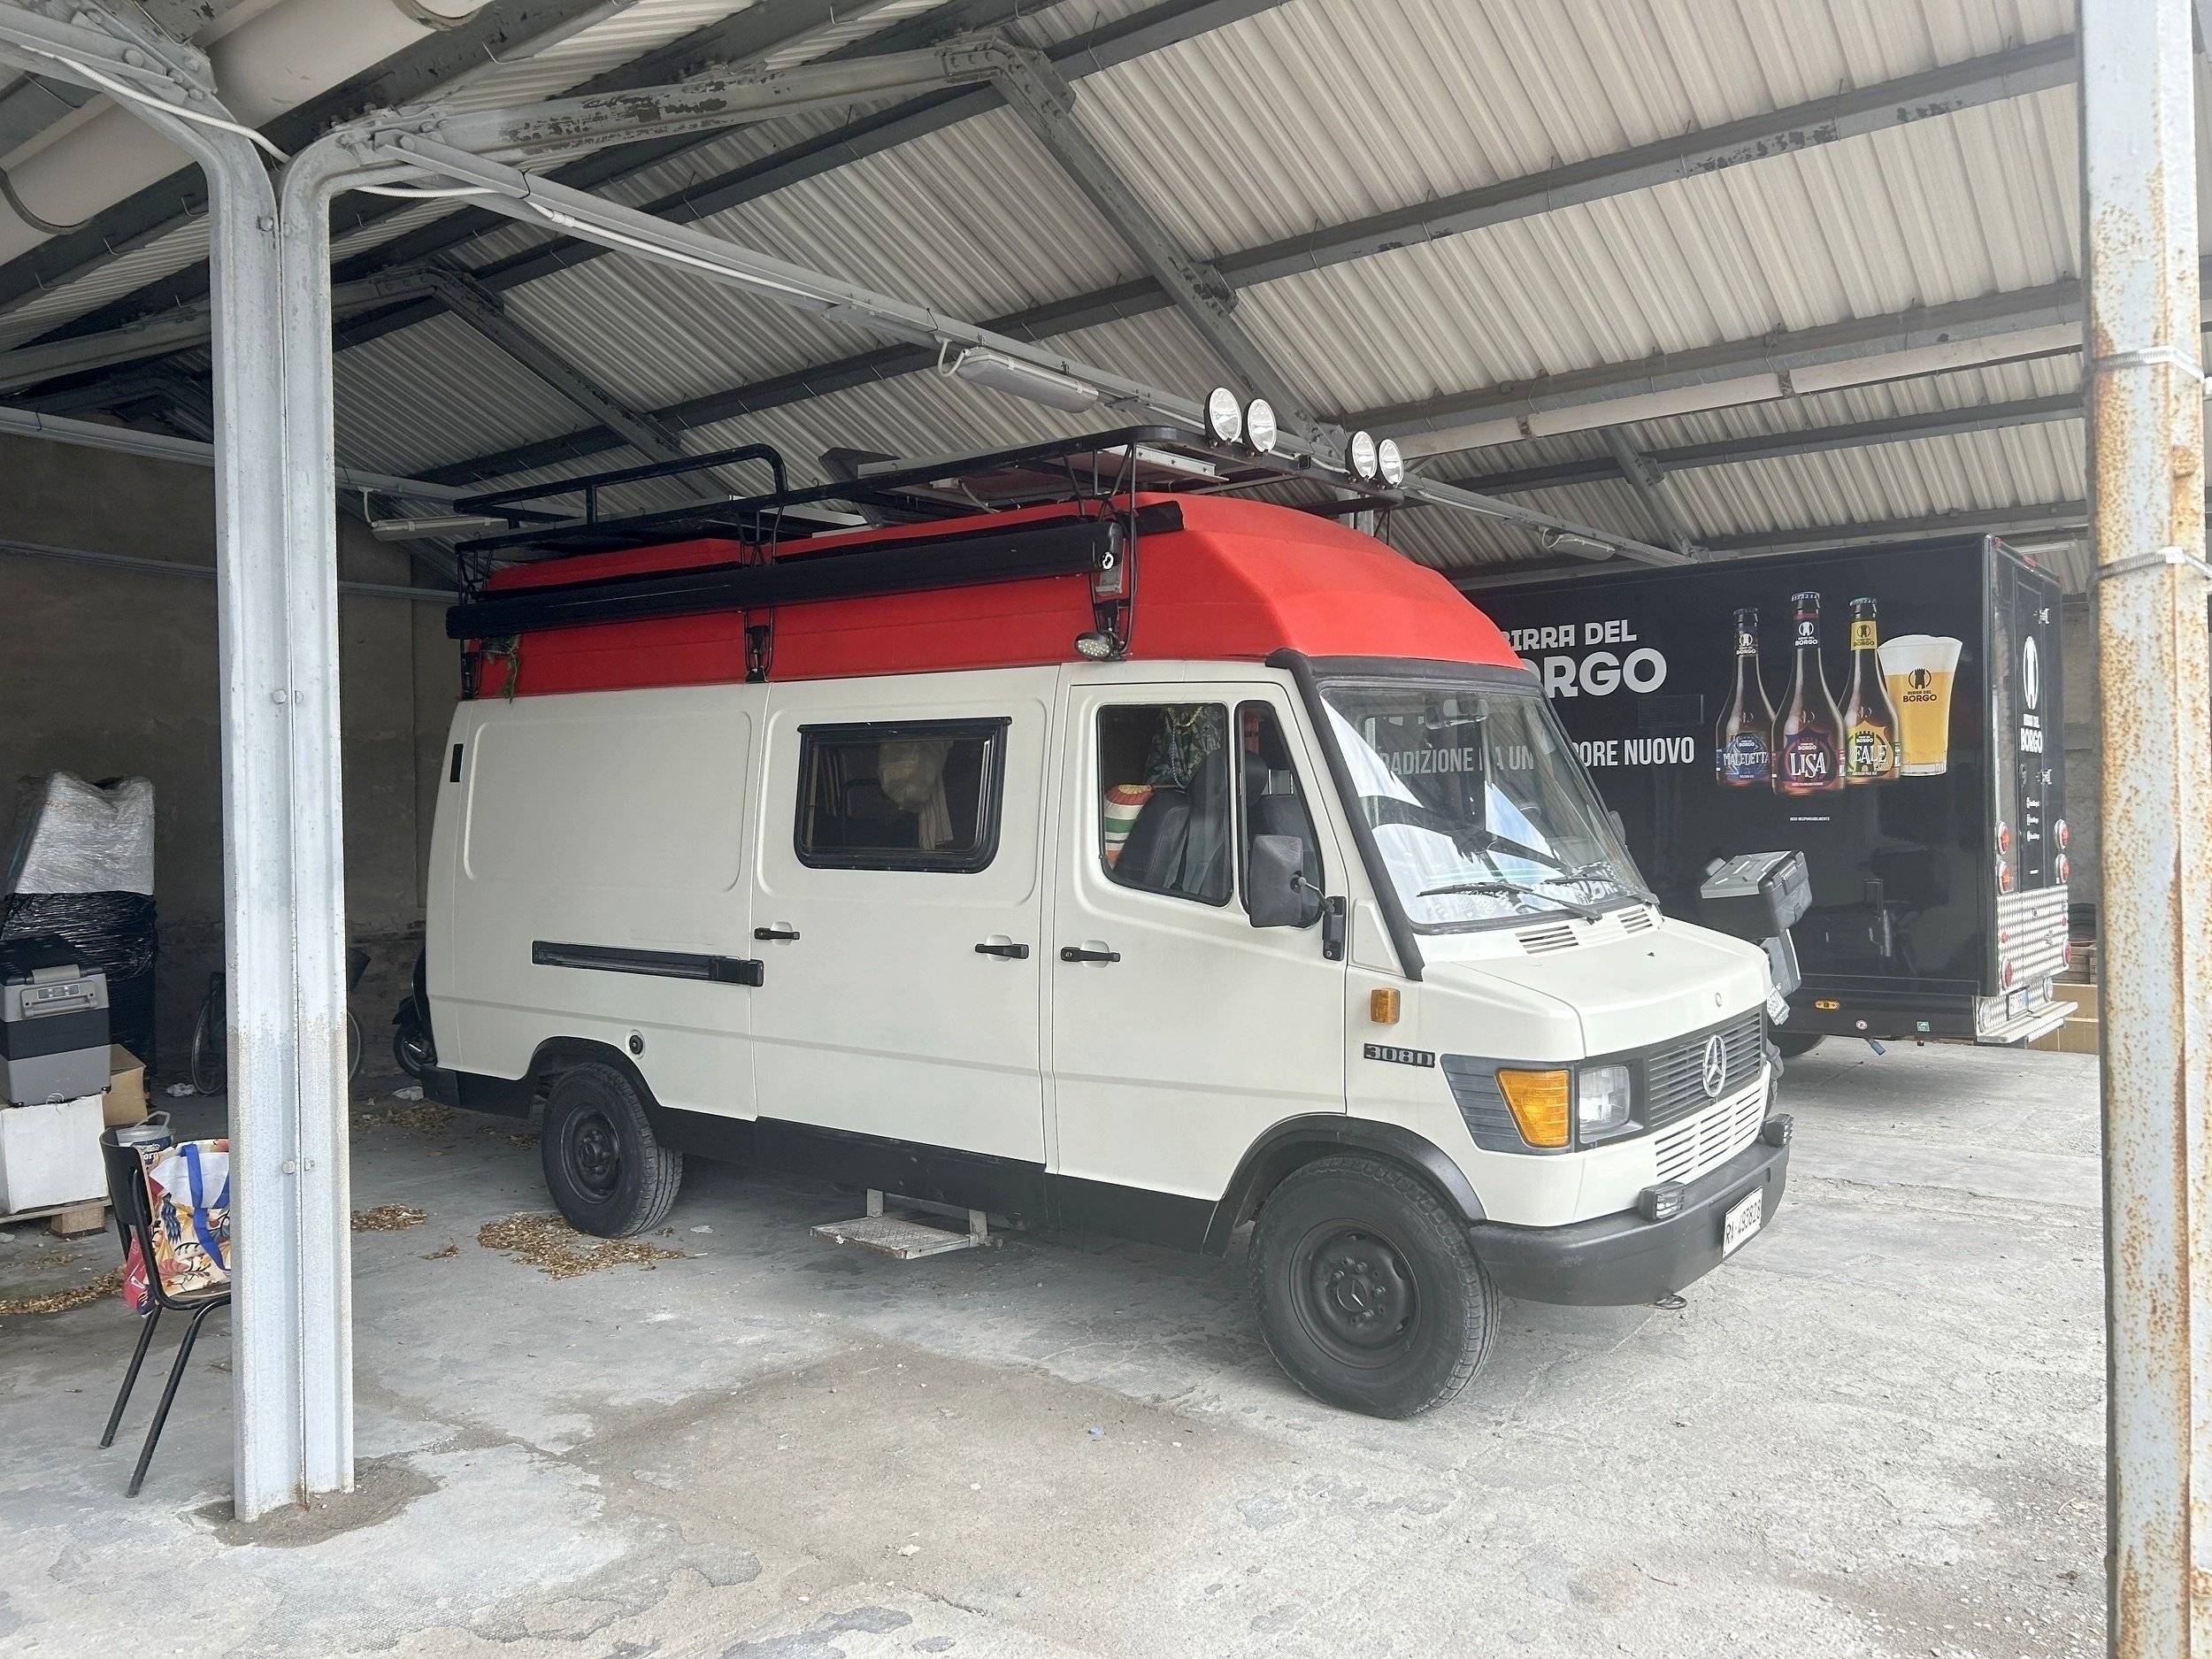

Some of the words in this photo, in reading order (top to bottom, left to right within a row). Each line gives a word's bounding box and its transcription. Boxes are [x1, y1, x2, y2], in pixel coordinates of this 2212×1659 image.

[1585, 619, 1637, 645] DEL
[1520, 648, 1667, 698] RGO
[1903, 694, 1938, 703] BORGO
[2020, 727, 2042, 754] BORGO
[1379, 747, 1474, 775] RADIZIONE
[1509, 745, 1534, 772] UN
[1624, 736, 1694, 765] NUOVO
[1790, 752, 1827, 778] LISA
[1365, 1045, 1433, 1065] 308D
